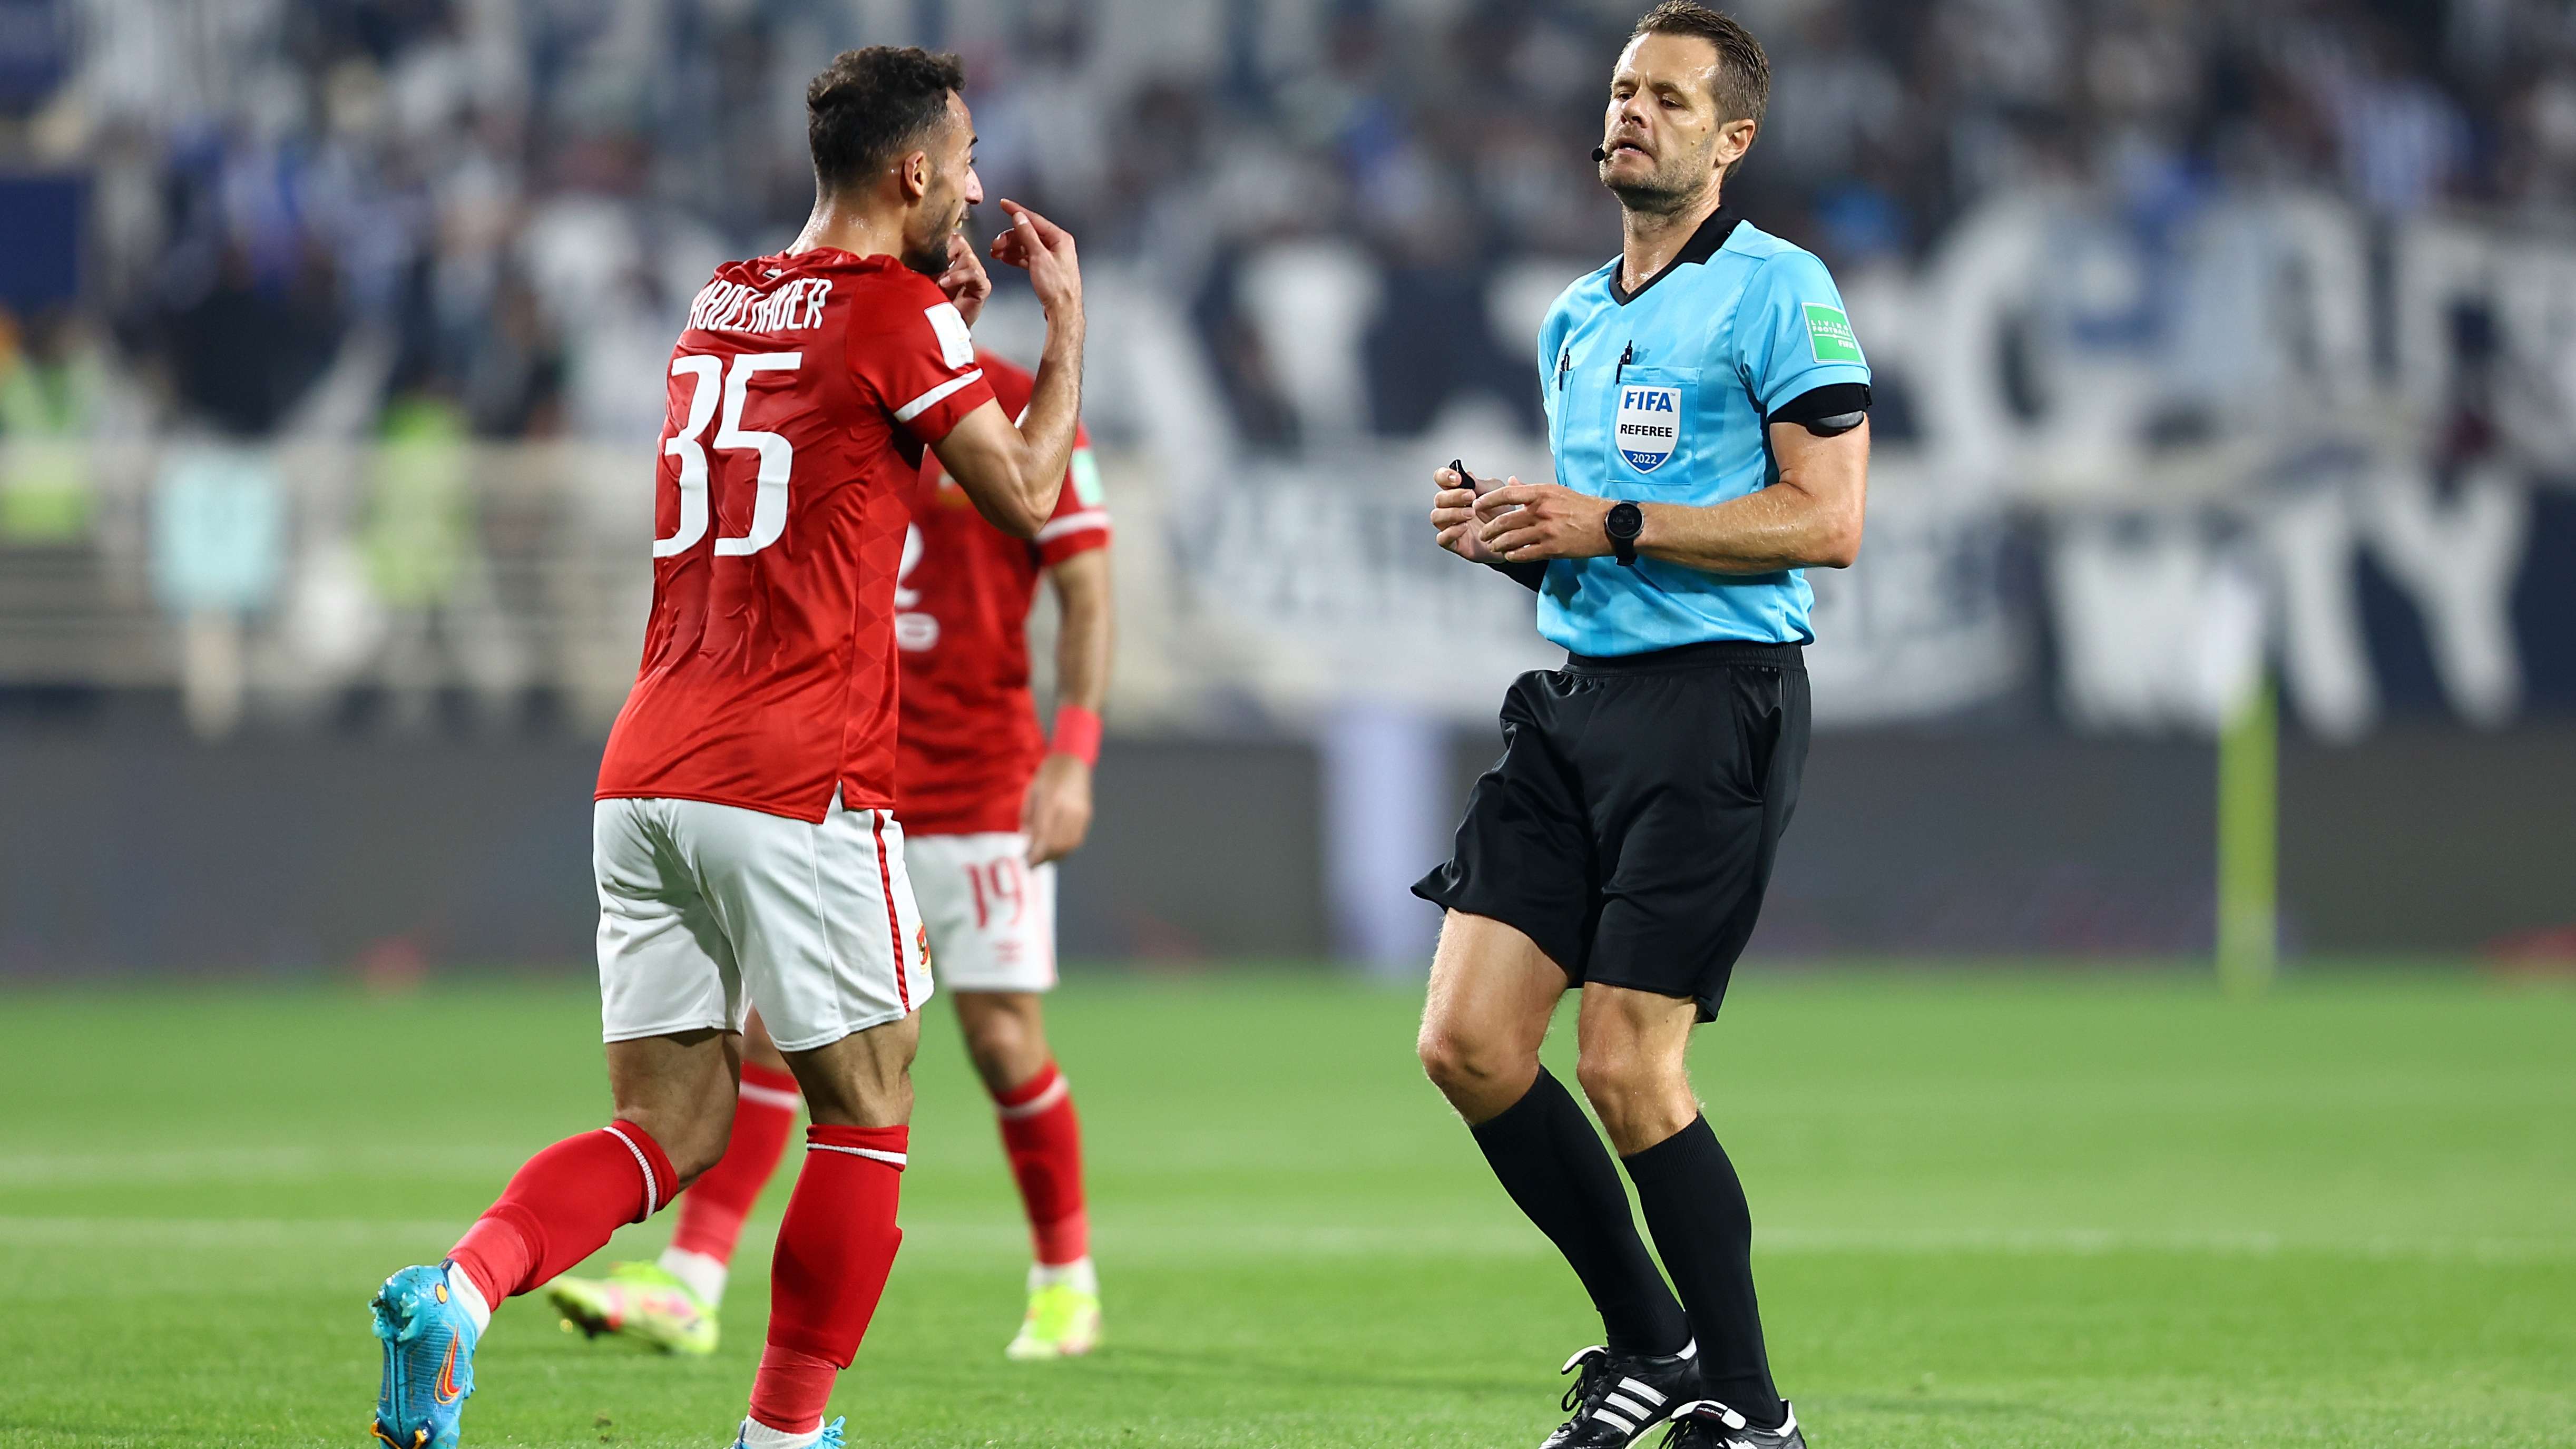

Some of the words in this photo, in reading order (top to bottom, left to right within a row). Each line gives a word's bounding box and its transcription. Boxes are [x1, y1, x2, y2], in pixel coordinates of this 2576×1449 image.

[1812, 326, 1852, 337] FOOTBALL
[1837, 339, 1855, 350] FIFA
[1624, 390, 1673, 413] FIFA
[1620, 424, 1673, 438] REFEREE
[653, 351, 803, 558] 35
[1632, 453, 1657, 464] 2022
[965, 856, 1024, 929] 19
